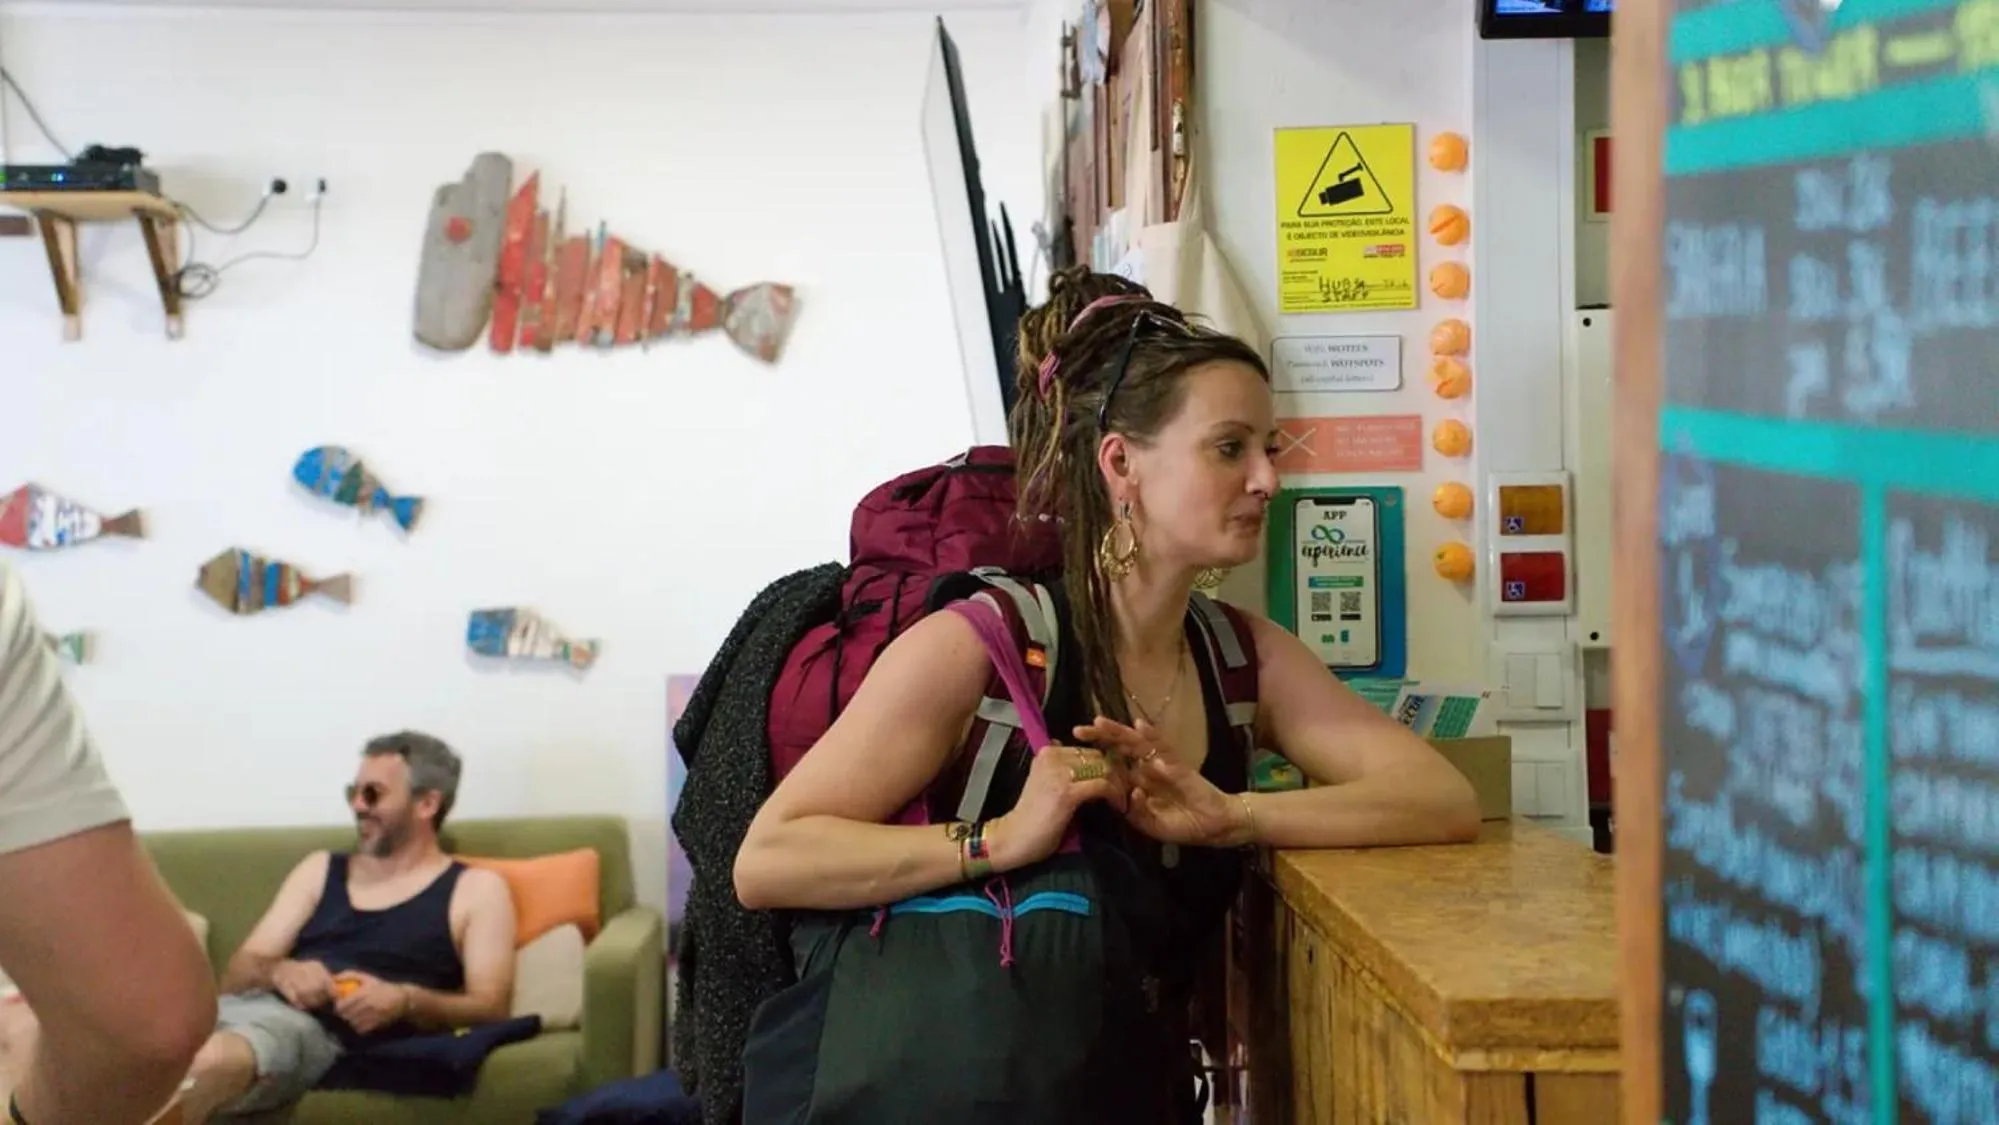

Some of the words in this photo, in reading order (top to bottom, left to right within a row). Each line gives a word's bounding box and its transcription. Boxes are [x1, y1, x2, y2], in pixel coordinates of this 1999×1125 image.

[1385, 216, 1410, 226] LOCAL
[1328, 231, 1339, 239] DE
[1323, 510, 1348, 521] APP
